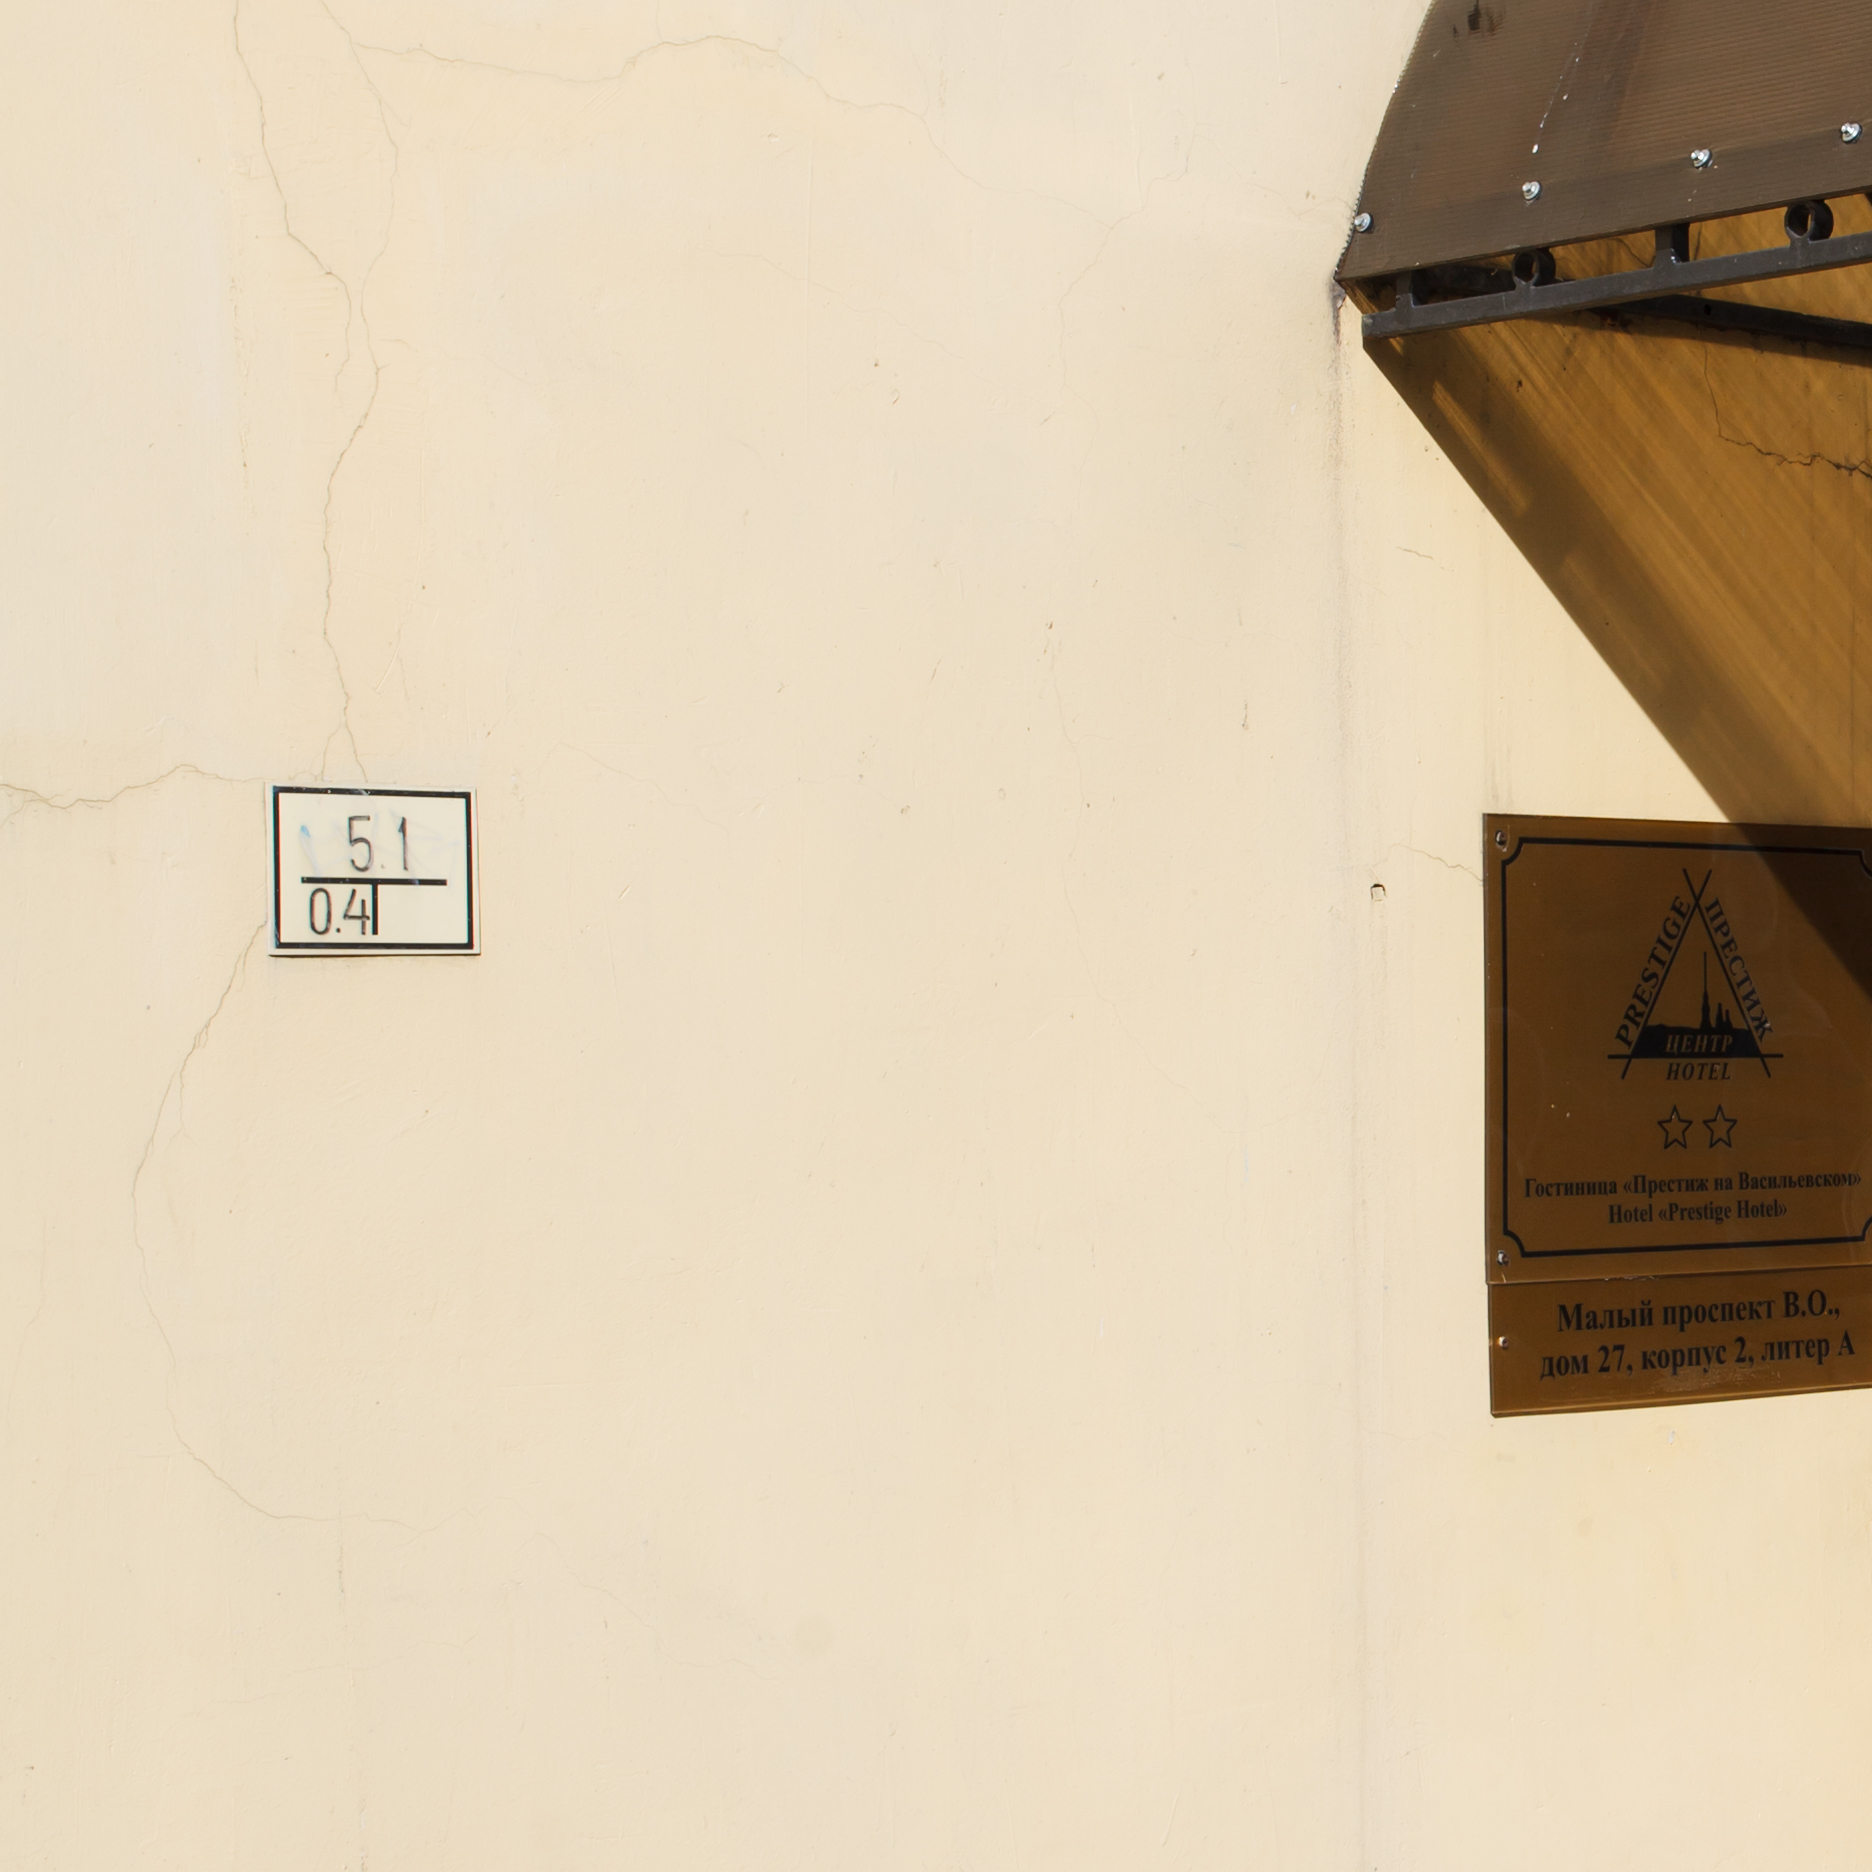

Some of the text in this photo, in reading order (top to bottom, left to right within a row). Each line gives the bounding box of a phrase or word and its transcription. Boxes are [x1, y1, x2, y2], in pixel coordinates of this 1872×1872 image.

[309, 888, 370, 935] 0.4
[1615, 895, 1691, 1049] PRESTIGE
[1705, 897, 1773, 1042] ПРЕСТИЖ
[1665, 1034, 1733, 1055] ЦЕНТР
[1665, 1062, 1731, 1081] HOTEL
[1524, 1171, 1862, 1199] Гостиница «Престиж на Васильевском»
[1608, 1199, 1787, 1225] Hotel «Prestige Hotel»
[1557, 1289, 1840, 1332] Малый проспект В.О.,
[1540, 1354, 1589, 1380] дом
[1597, 1344, 1633, 1376] 27,
[1641, 1344, 1727, 1376] корпус
[1734, 1336, 1755, 1368] 2,
[1761, 1337, 1830, 1365] литер
